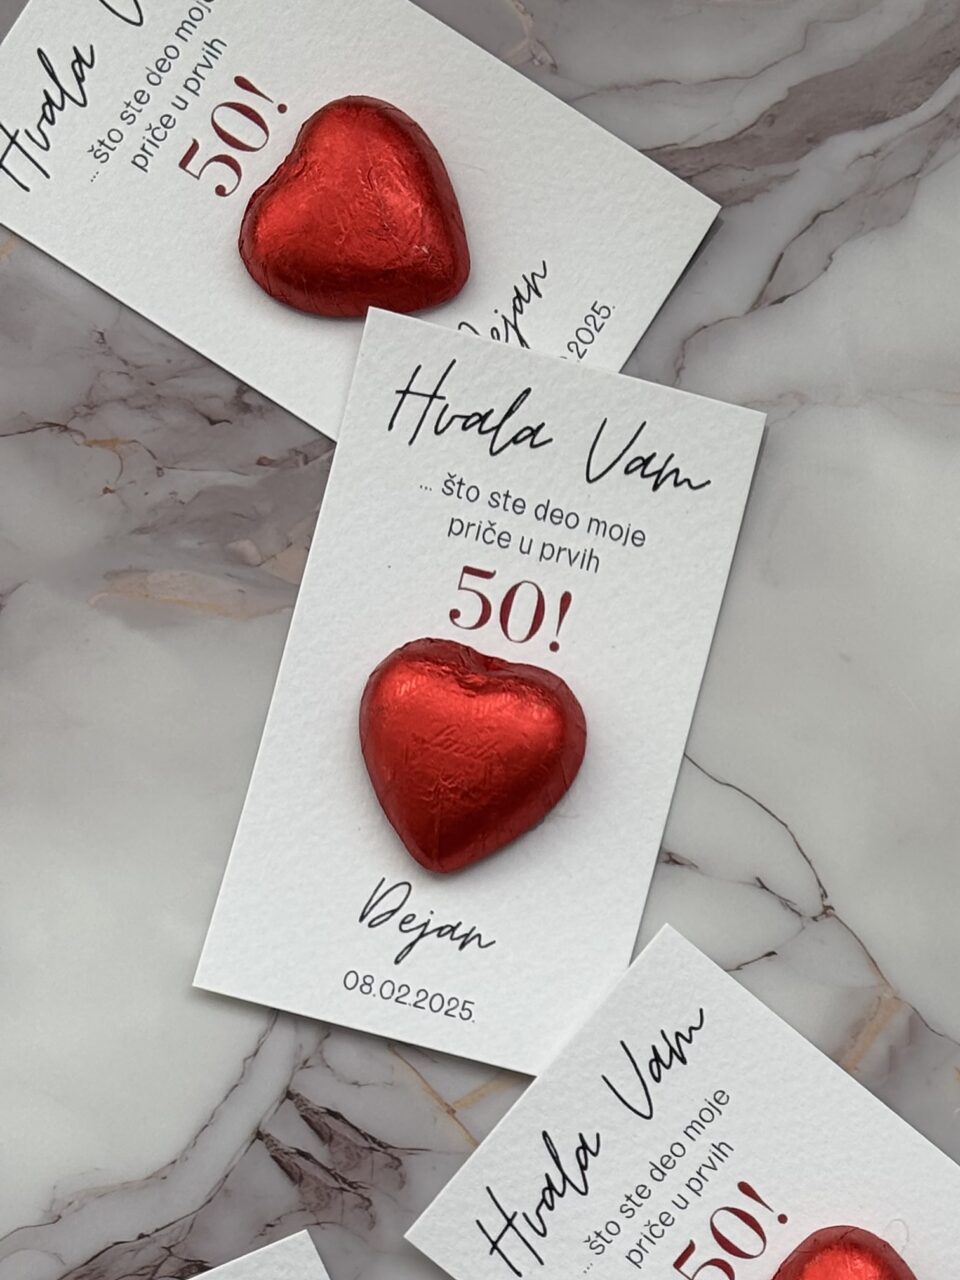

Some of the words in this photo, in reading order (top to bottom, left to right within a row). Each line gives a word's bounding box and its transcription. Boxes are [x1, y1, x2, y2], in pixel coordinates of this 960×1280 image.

[0, 44, 95, 192] Hvala
[87, 128, 124, 164] što
[120, 89, 150, 126] ste
[145, 45, 180, 86] deo
[175, 0, 214, 42] moj
[130, 114, 176, 173] priče
[171, 95, 189, 111] u
[182, 38, 227, 97] prvih
[178, 76, 288, 198] 50!
[388, 358, 553, 457] Hvala
[585, 417, 711, 493] Vam
[441, 472, 480, 503] što
[488, 490, 526, 515] ste
[534, 499, 580, 530] deo
[587, 517, 646, 547] moje
[448, 517, 511, 549] priče
[519, 536, 533, 555] u
[539, 542, 599, 574] prvih
[449, 565, 572, 653] 50!
[358, 877, 496, 965] Dejan
[343, 970, 475, 1023] 08.02.2025.
[475, 1130, 601, 1278] Hvala
[601, 1008, 704, 1120] Vam
[583, 1220, 621, 1255] što
[619, 1184, 651, 1219] ste
[649, 1142, 686, 1182] deo
[683, 1090, 730, 1142] moje
[625, 1211, 675, 1269] priče
[671, 1193, 690, 1210] u
[685, 1142, 734, 1197] prvih
